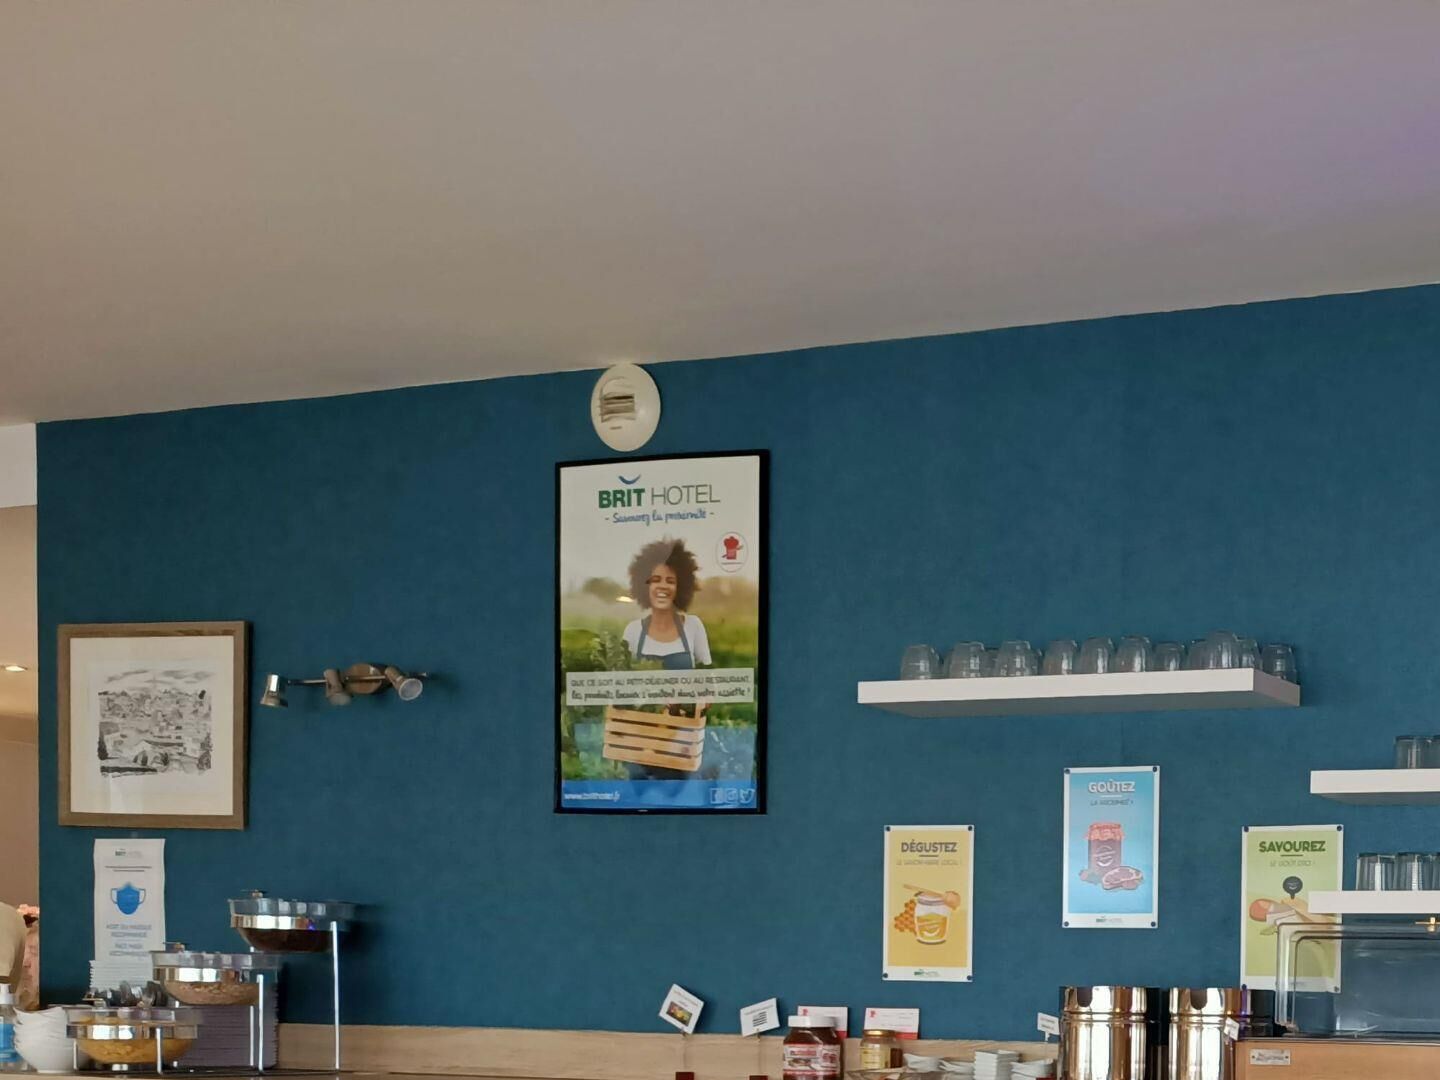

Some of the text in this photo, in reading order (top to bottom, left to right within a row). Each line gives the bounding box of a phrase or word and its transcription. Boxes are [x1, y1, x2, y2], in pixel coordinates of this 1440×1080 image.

[598, 484, 721, 508] BRIT HOTEL
[1088, 778, 1135, 793] GOÛTEZ
[901, 838, 958, 853] DÉGUSTEZ
[1259, 840, 1326, 853] SAVOUREZ
